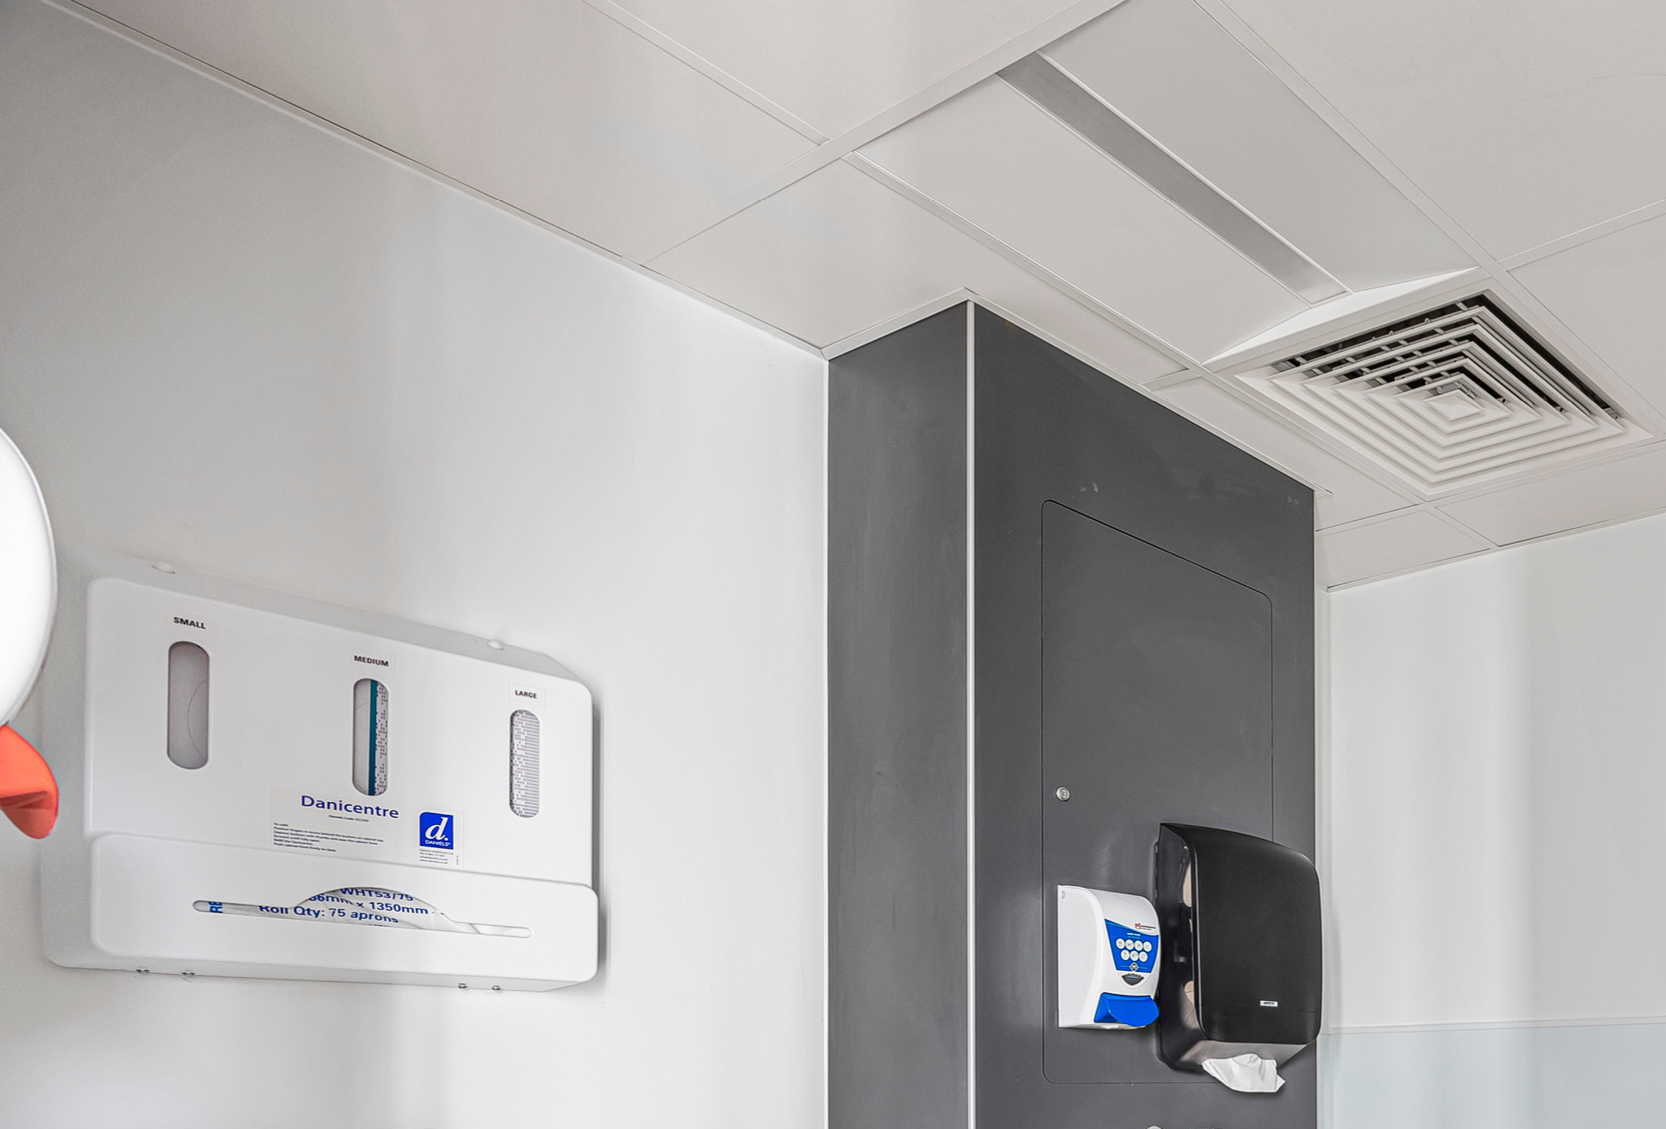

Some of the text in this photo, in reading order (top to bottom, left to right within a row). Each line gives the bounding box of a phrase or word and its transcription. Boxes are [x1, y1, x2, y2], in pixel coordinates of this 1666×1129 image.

[173, 616, 206, 629] SMALL
[354, 655, 389, 667] MEDIUM
[515, 690, 537, 699] LARGE
[301, 795, 399, 819] Danicentre
[369, 902, 428, 914] 1350mm
[294, 906, 325, 918] Qty:
[328, 908, 346, 917] 75
[350, 911, 399, 923] aprons
